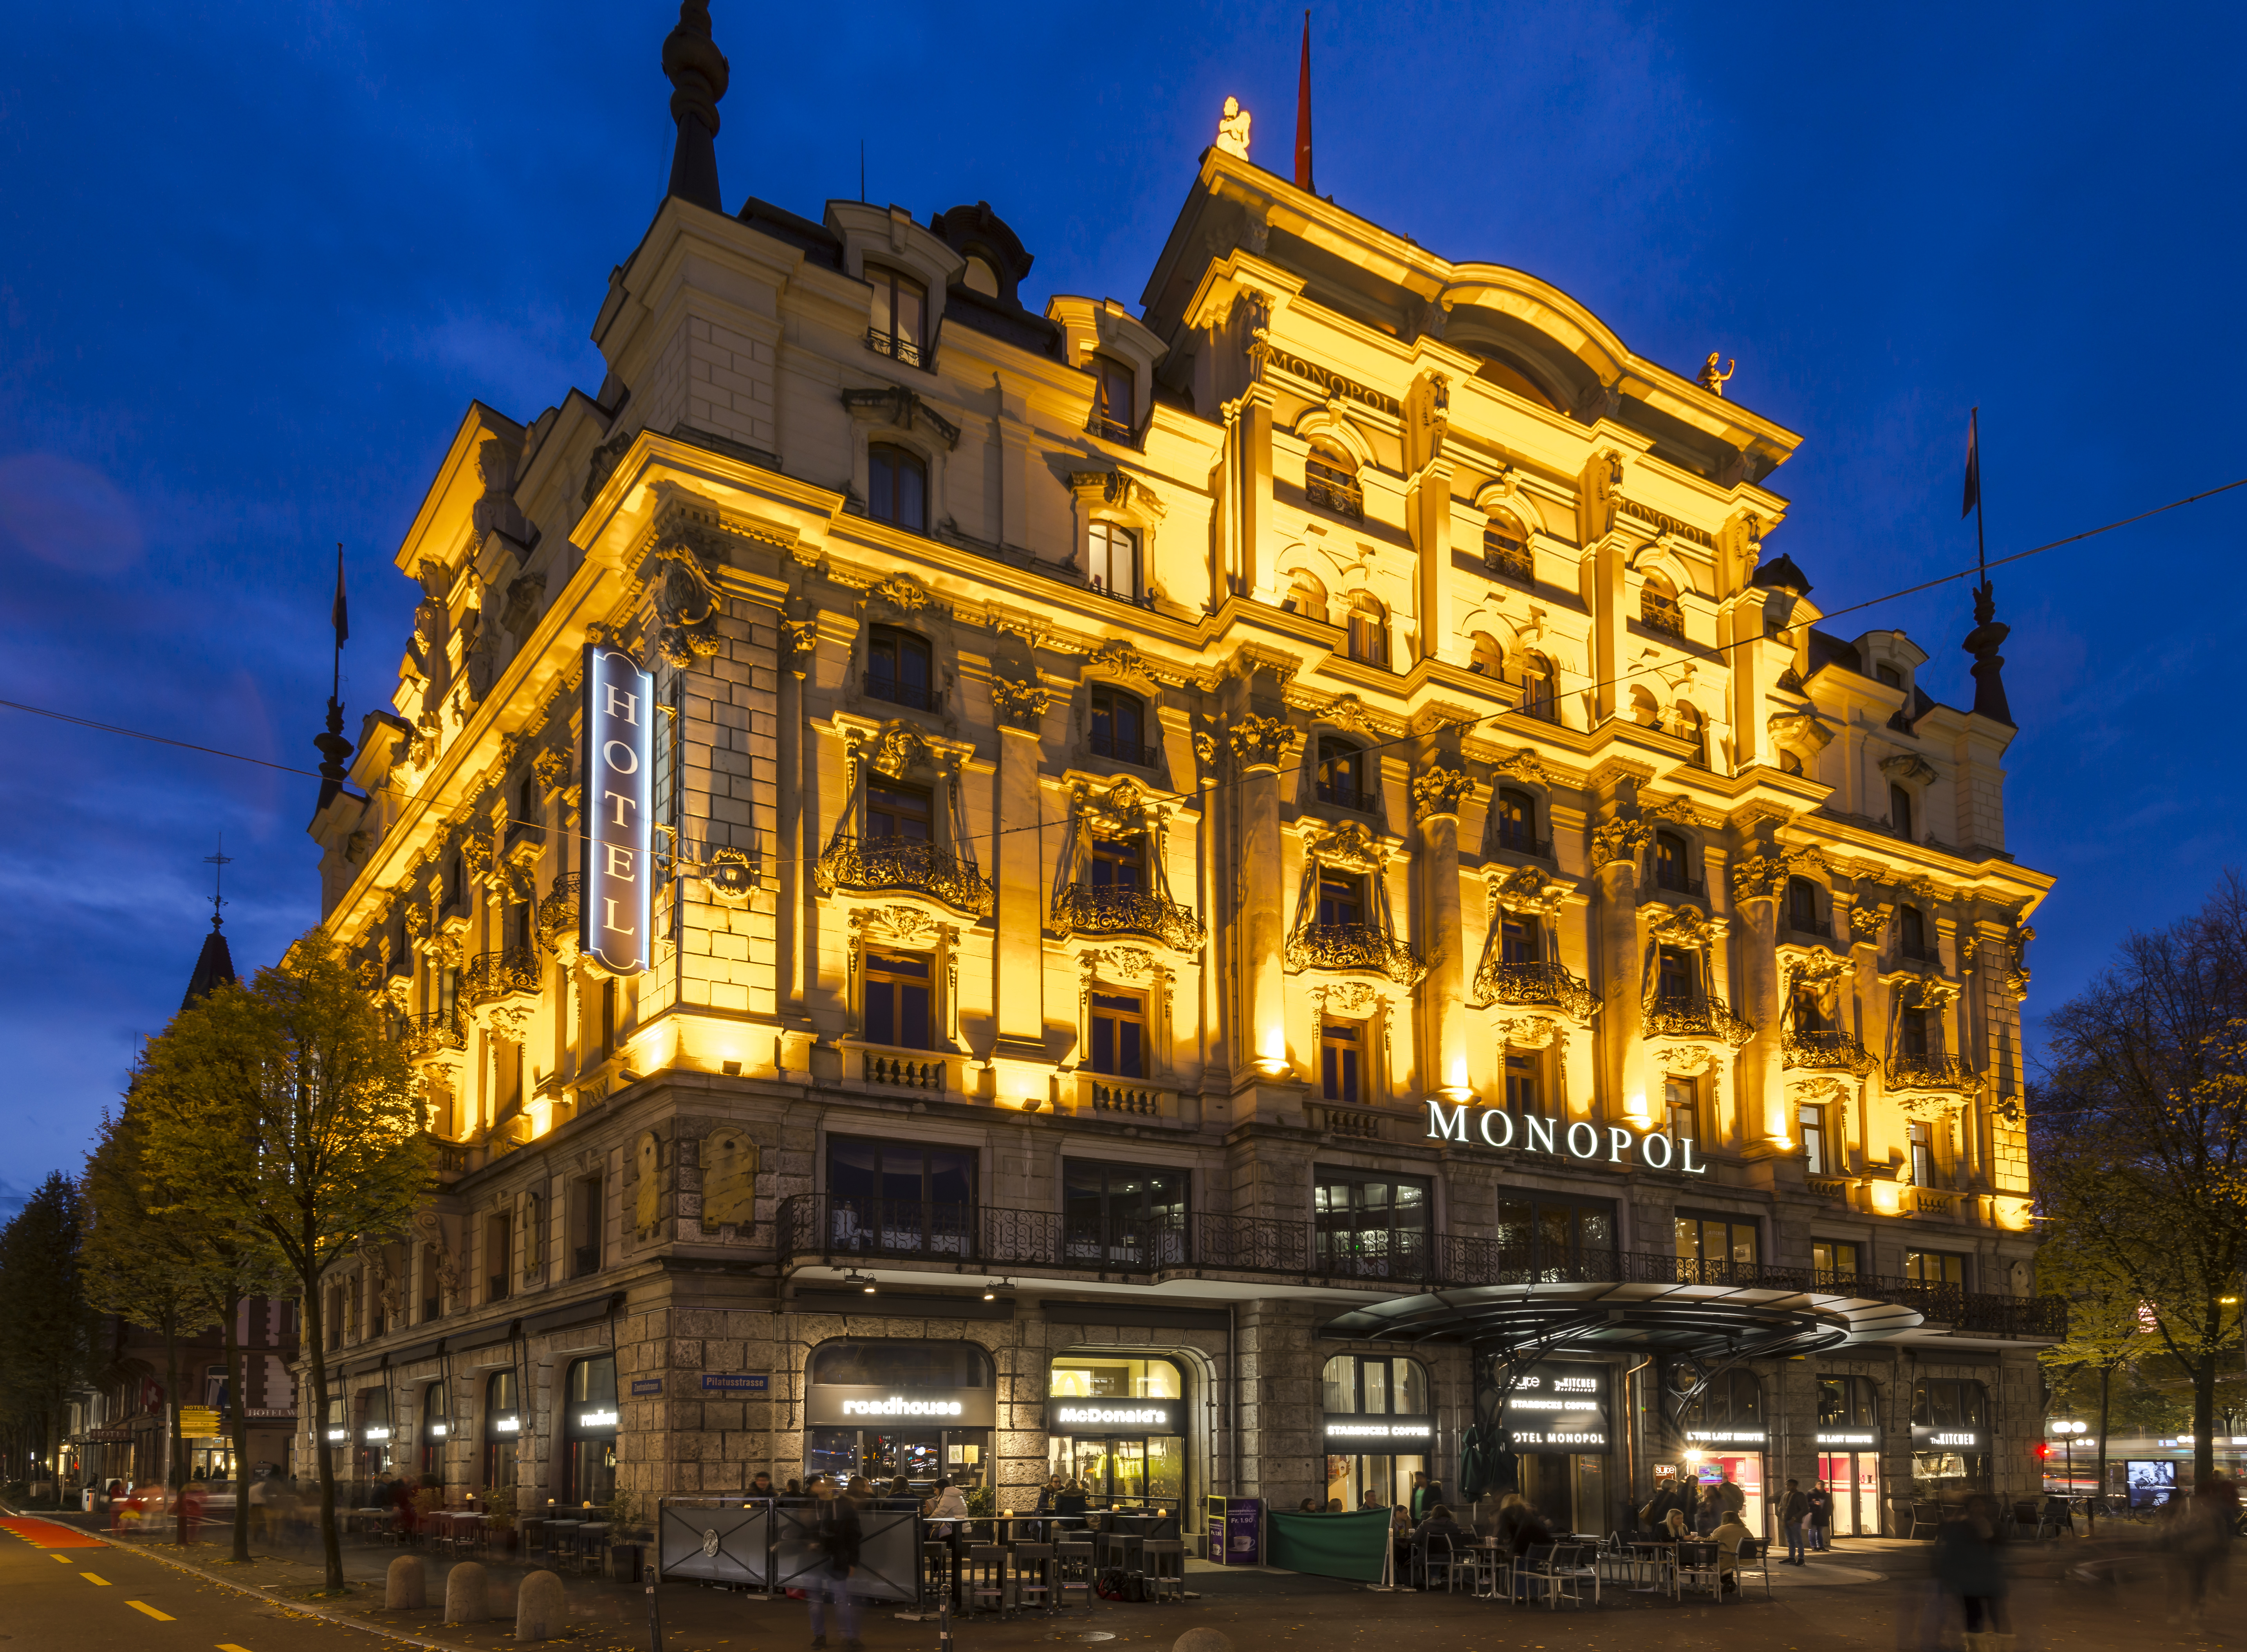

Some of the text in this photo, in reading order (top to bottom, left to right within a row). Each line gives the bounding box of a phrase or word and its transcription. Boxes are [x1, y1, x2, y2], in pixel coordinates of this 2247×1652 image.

[1267, 348, 1396, 417] MONOPOL
[602, 682, 639, 935] HOTEL
[1426, 1100, 1706, 1173] MONOPOL
[707, 1377, 763, 1387] Pilatusstrasse
[1563, 1378, 1596, 1388] KITCHEN
[634, 1383, 658, 1392] Zentralstrasse
[1713, 1394, 1729, 1403] BAR
[843, 1397, 962, 1415] roadhouse
[1511, 1400, 1596, 1410] STARBUCKS COFFEE
[1059, 1408, 1166, 1423] McDonald's
[1328, 1426, 1429, 1435] STARBUCKS COFFEE
[1513, 1433, 1604, 1443] OTEL MONOPOL
[1712, 1432, 1733, 1441] LAST
[1940, 1434, 1974, 1444] KITCHEN
[1656, 1467, 1675, 1476] suite
